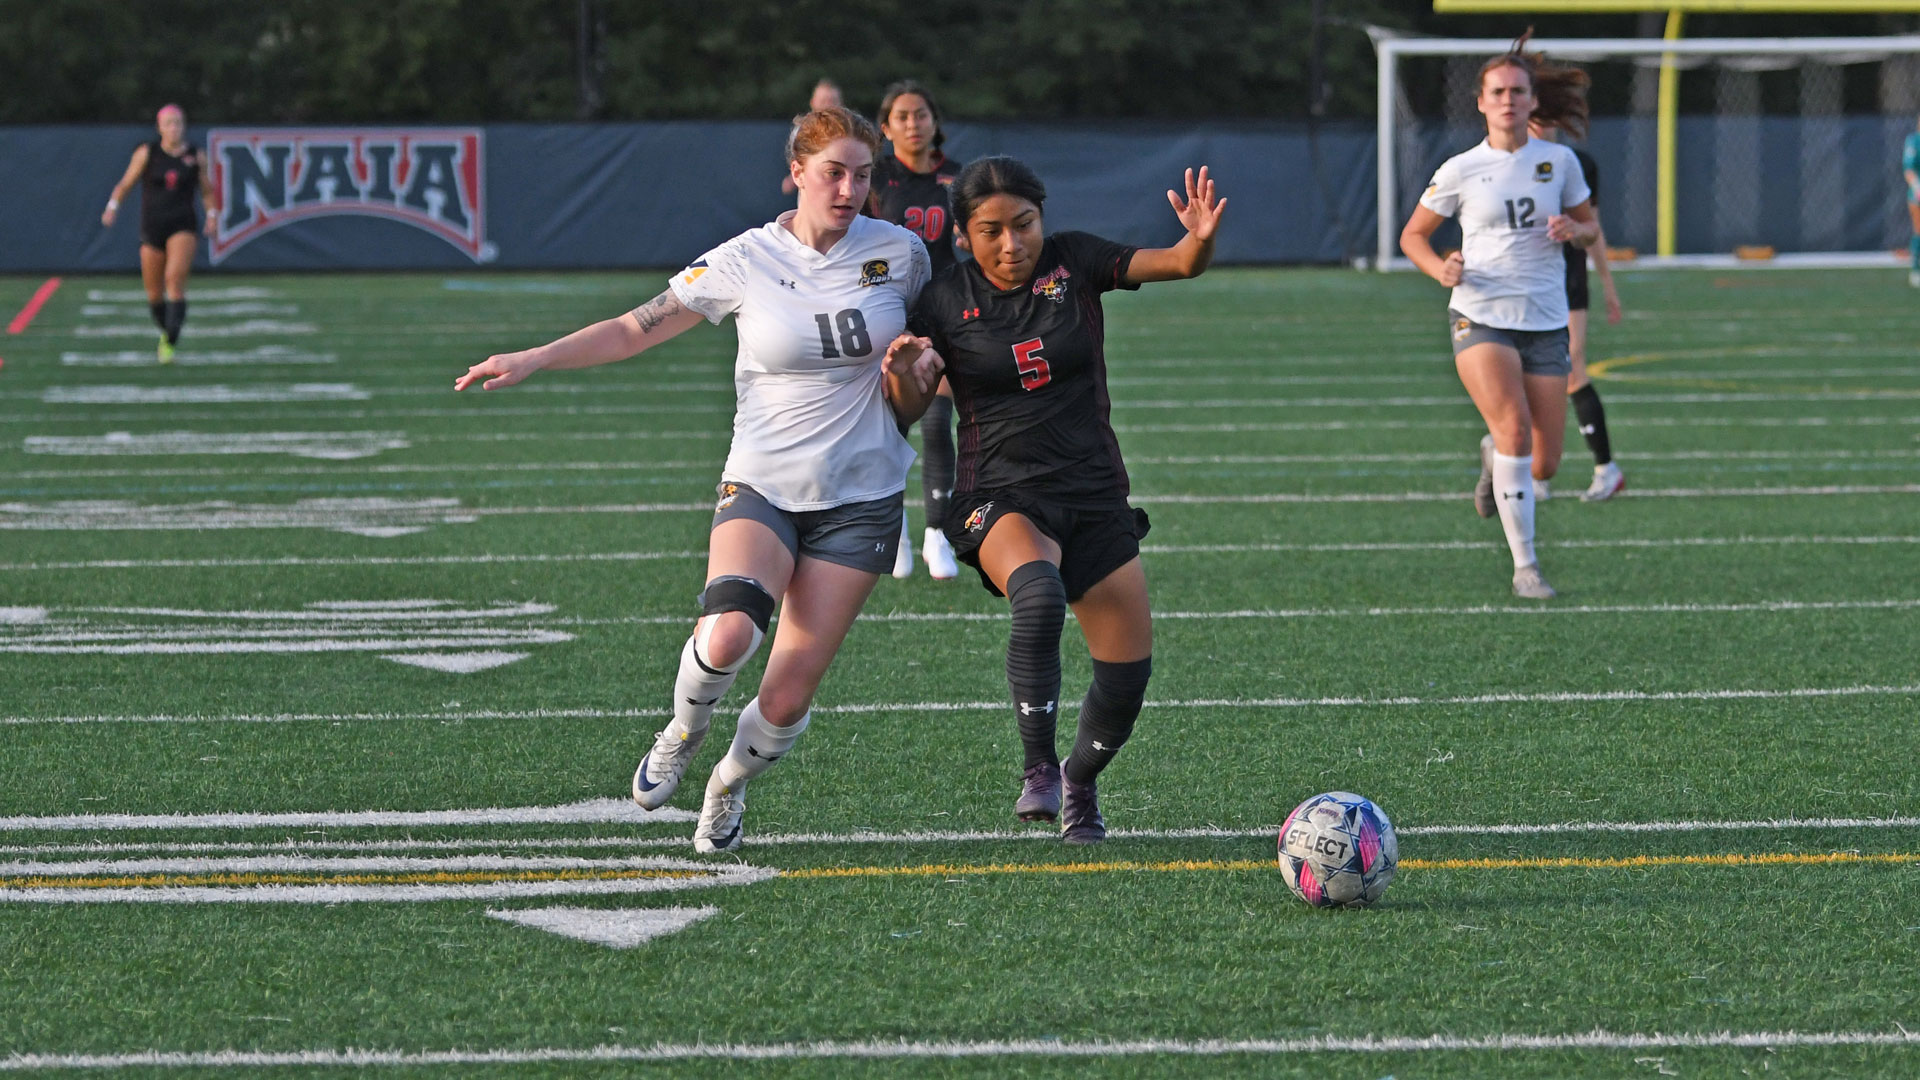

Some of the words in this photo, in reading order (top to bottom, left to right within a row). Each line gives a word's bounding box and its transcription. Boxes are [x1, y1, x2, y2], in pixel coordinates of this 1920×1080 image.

[223, 145, 471, 231] NAIA
[904, 206, 944, 242] 20
[1504, 197, 1535, 229] 12
[814, 308, 873, 359] 18
[1012, 337, 1051, 391] 5
[1288, 829, 1348, 859] SELECT
